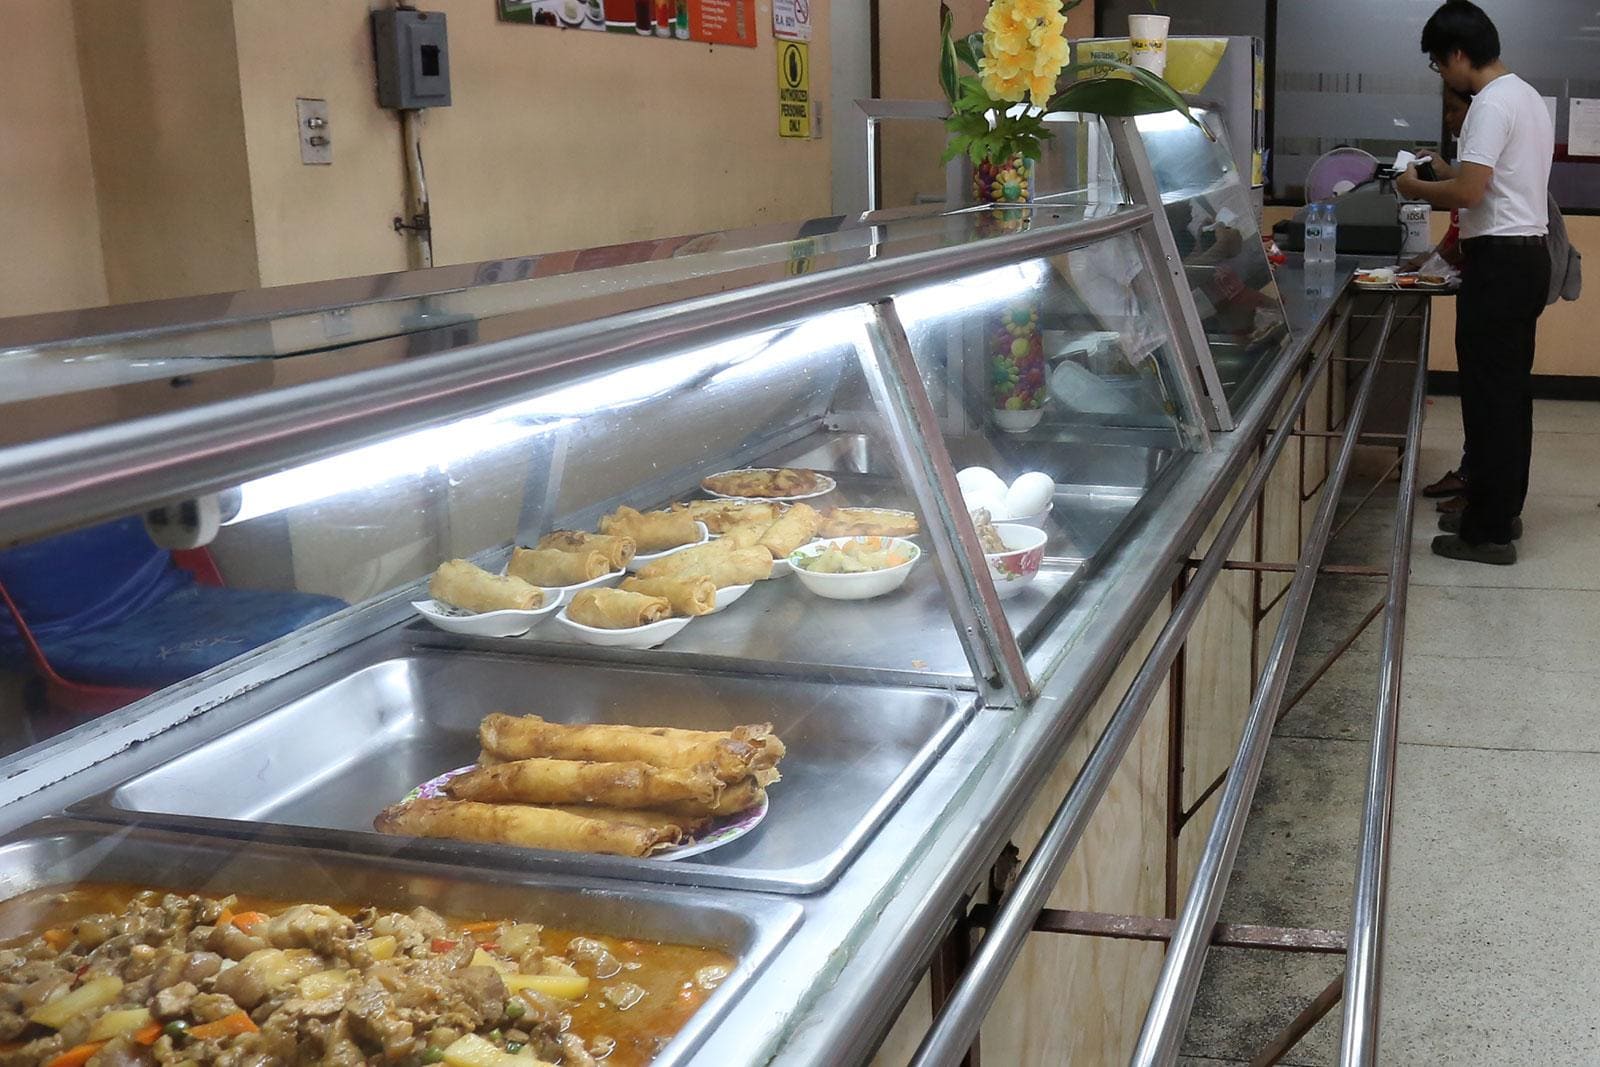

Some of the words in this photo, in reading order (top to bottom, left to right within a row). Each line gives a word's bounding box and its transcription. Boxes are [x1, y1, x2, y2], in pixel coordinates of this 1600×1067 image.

[780, 88, 807, 102] AUTHORIZED
[781, 103, 807, 118] PERSONNEL
[789, 119, 800, 132] ONLY
